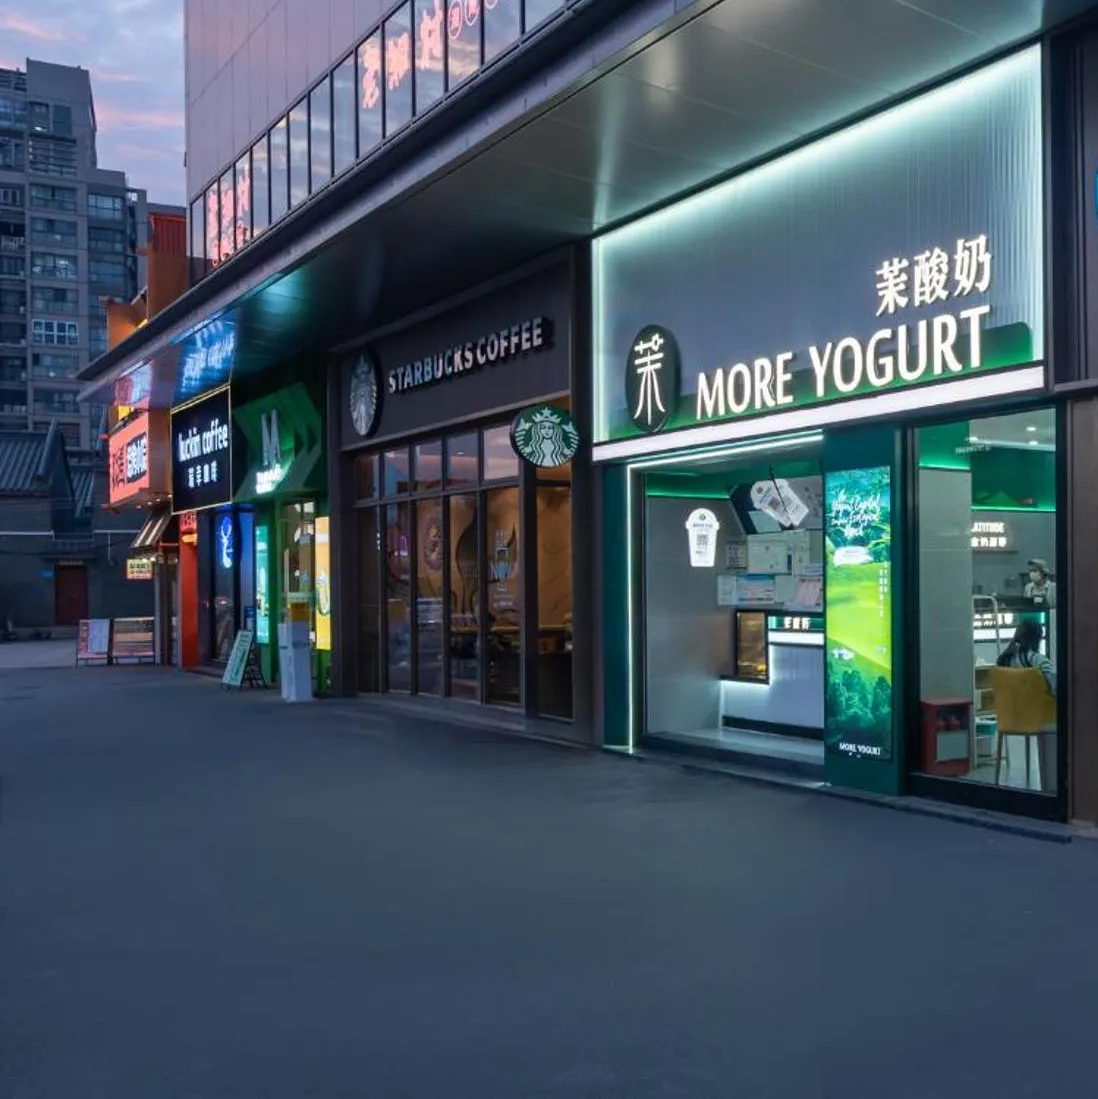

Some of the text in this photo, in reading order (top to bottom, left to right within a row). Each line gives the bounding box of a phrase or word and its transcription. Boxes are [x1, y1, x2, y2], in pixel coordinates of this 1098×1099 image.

[876, 234, 992, 317] 茉酸奶
[388, 317, 544, 394] STARBUCKS COFFEE
[696, 305, 992, 421] MORE YOGURT
[202, 418, 228, 455] coffee
